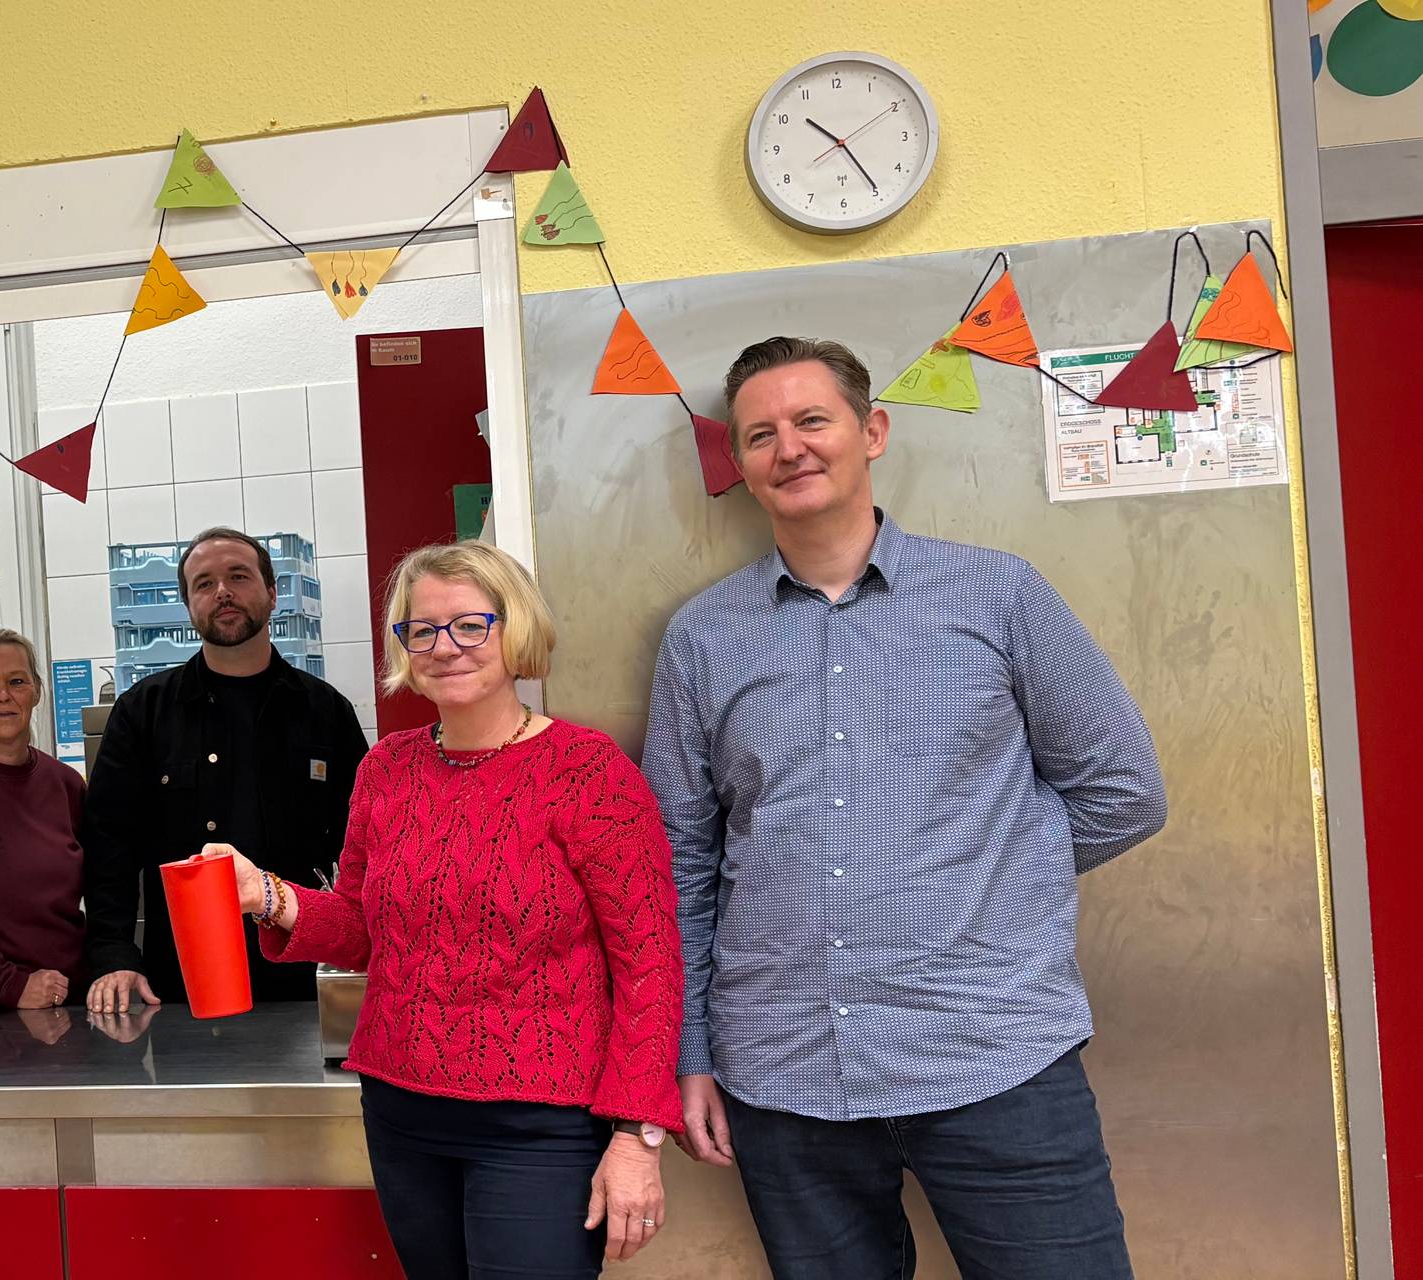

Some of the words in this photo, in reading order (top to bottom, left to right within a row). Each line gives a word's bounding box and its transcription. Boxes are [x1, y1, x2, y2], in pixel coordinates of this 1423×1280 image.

[832, 79, 842, 89] 12
[802, 90, 809, 100] 11
[891, 102, 898, 112] 2
[779, 114, 789, 125] 10
[902, 132, 908, 141] 3
[773, 146, 780, 155] 9
[894, 162, 901, 172] 4
[784, 174, 790, 184] 8
[873, 187, 878, 197] 5
[807, 194, 815, 203] 7
[841, 199, 847, 208] 6
